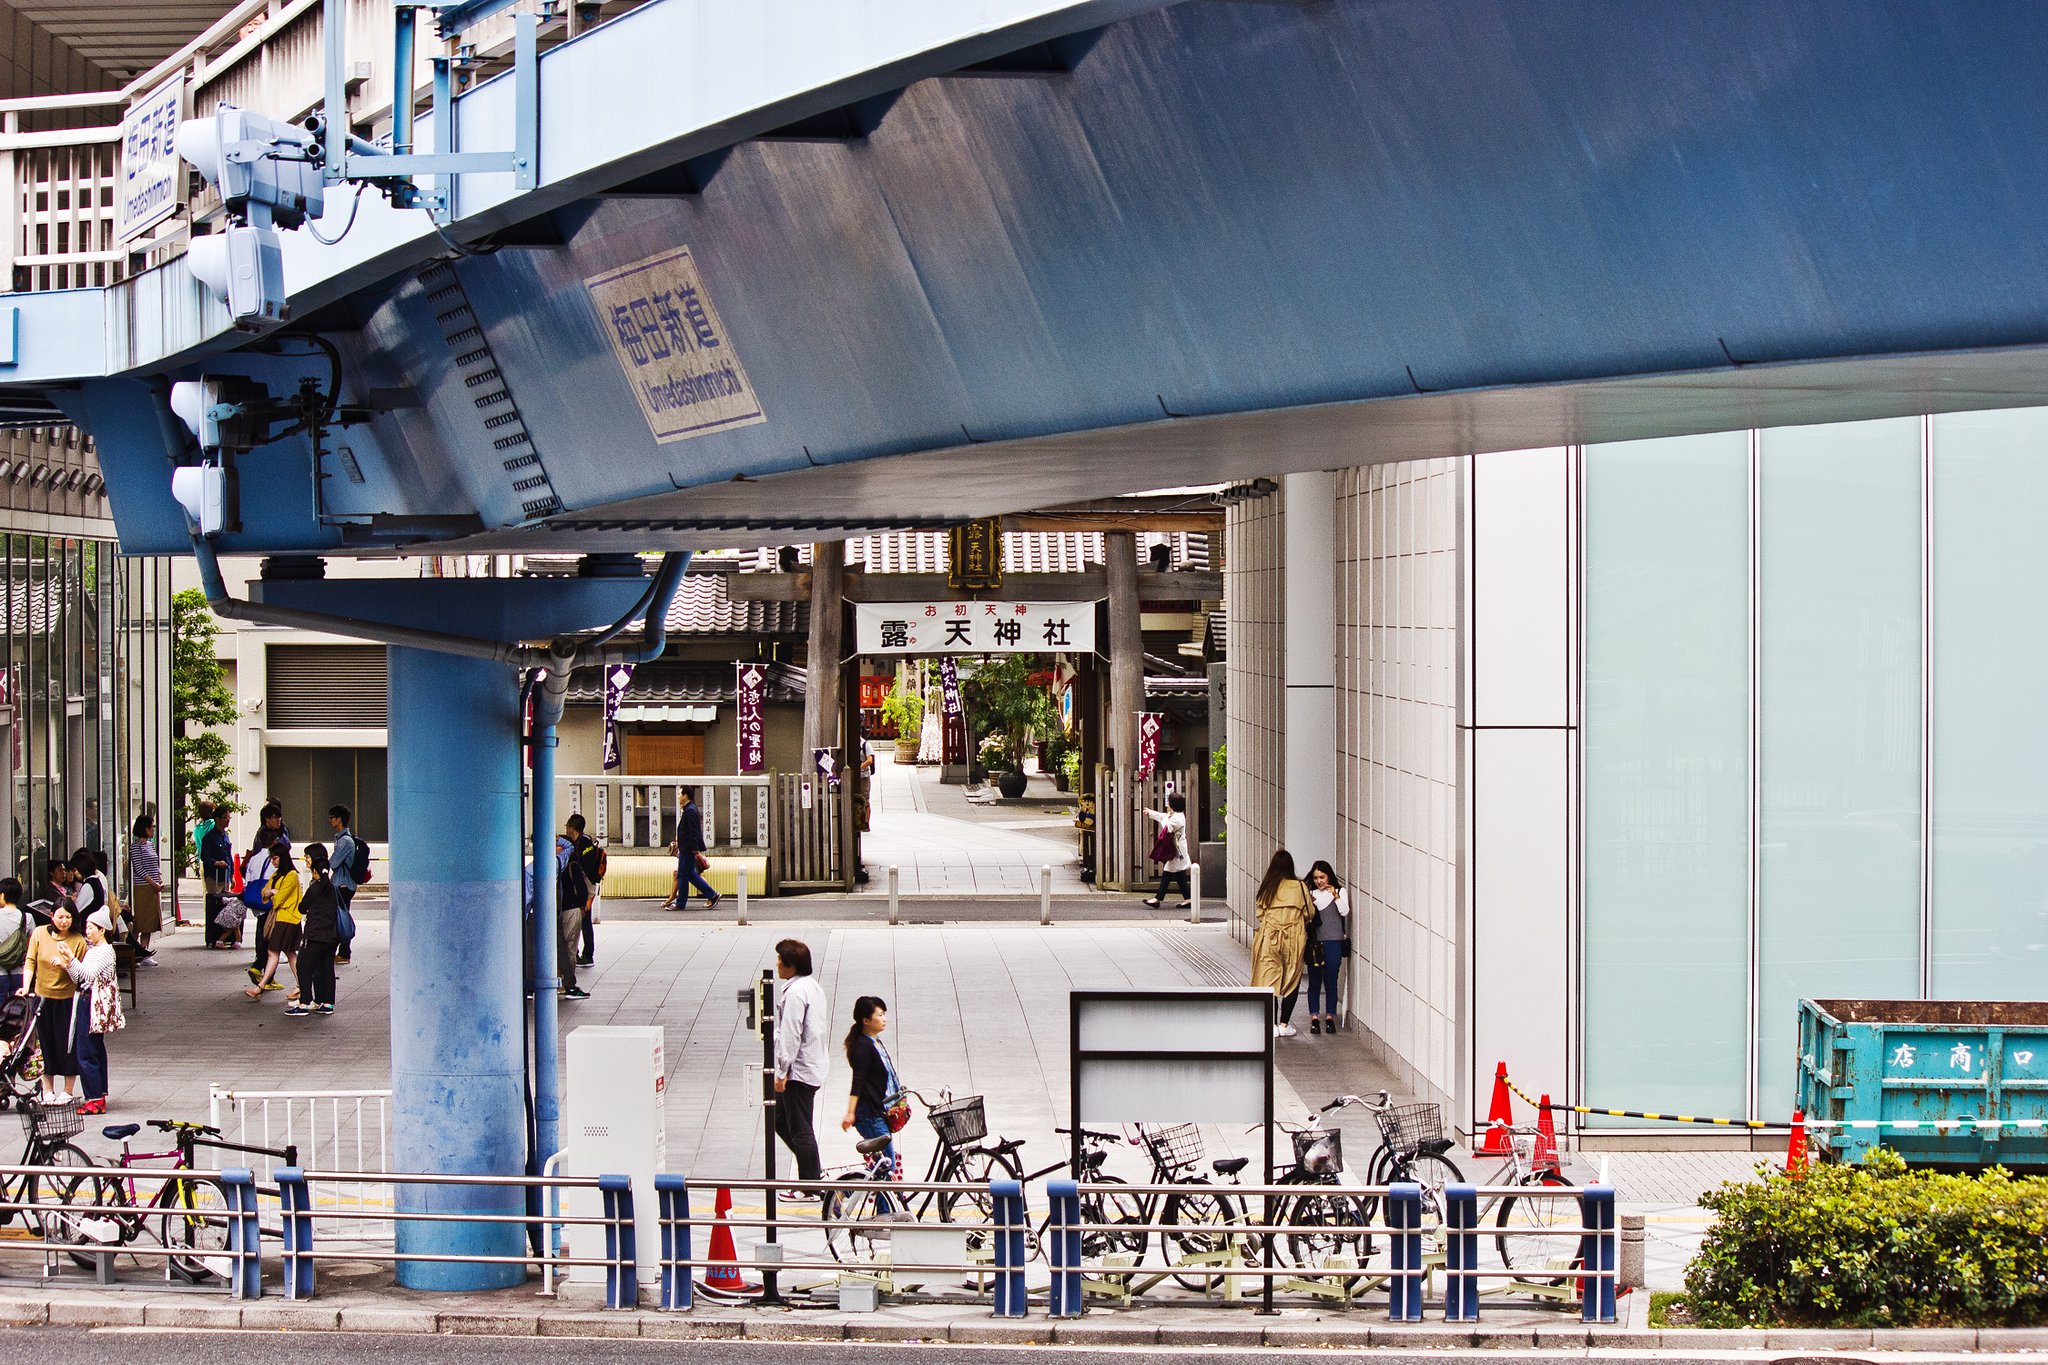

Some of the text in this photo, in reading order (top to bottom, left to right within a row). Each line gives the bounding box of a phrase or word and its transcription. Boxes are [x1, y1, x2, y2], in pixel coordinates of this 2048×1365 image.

[127, 93, 177, 181] 梅田新道
[123, 174, 173, 225] Umedashinmichi
[608, 281, 720, 369] 梅田新道
[640, 358, 743, 414] Umedashinmichi
[968, 523, 983, 572] 露天神社
[880, 618, 1071, 647] 露天神社
[925, 604, 1027, 617] お初天神
